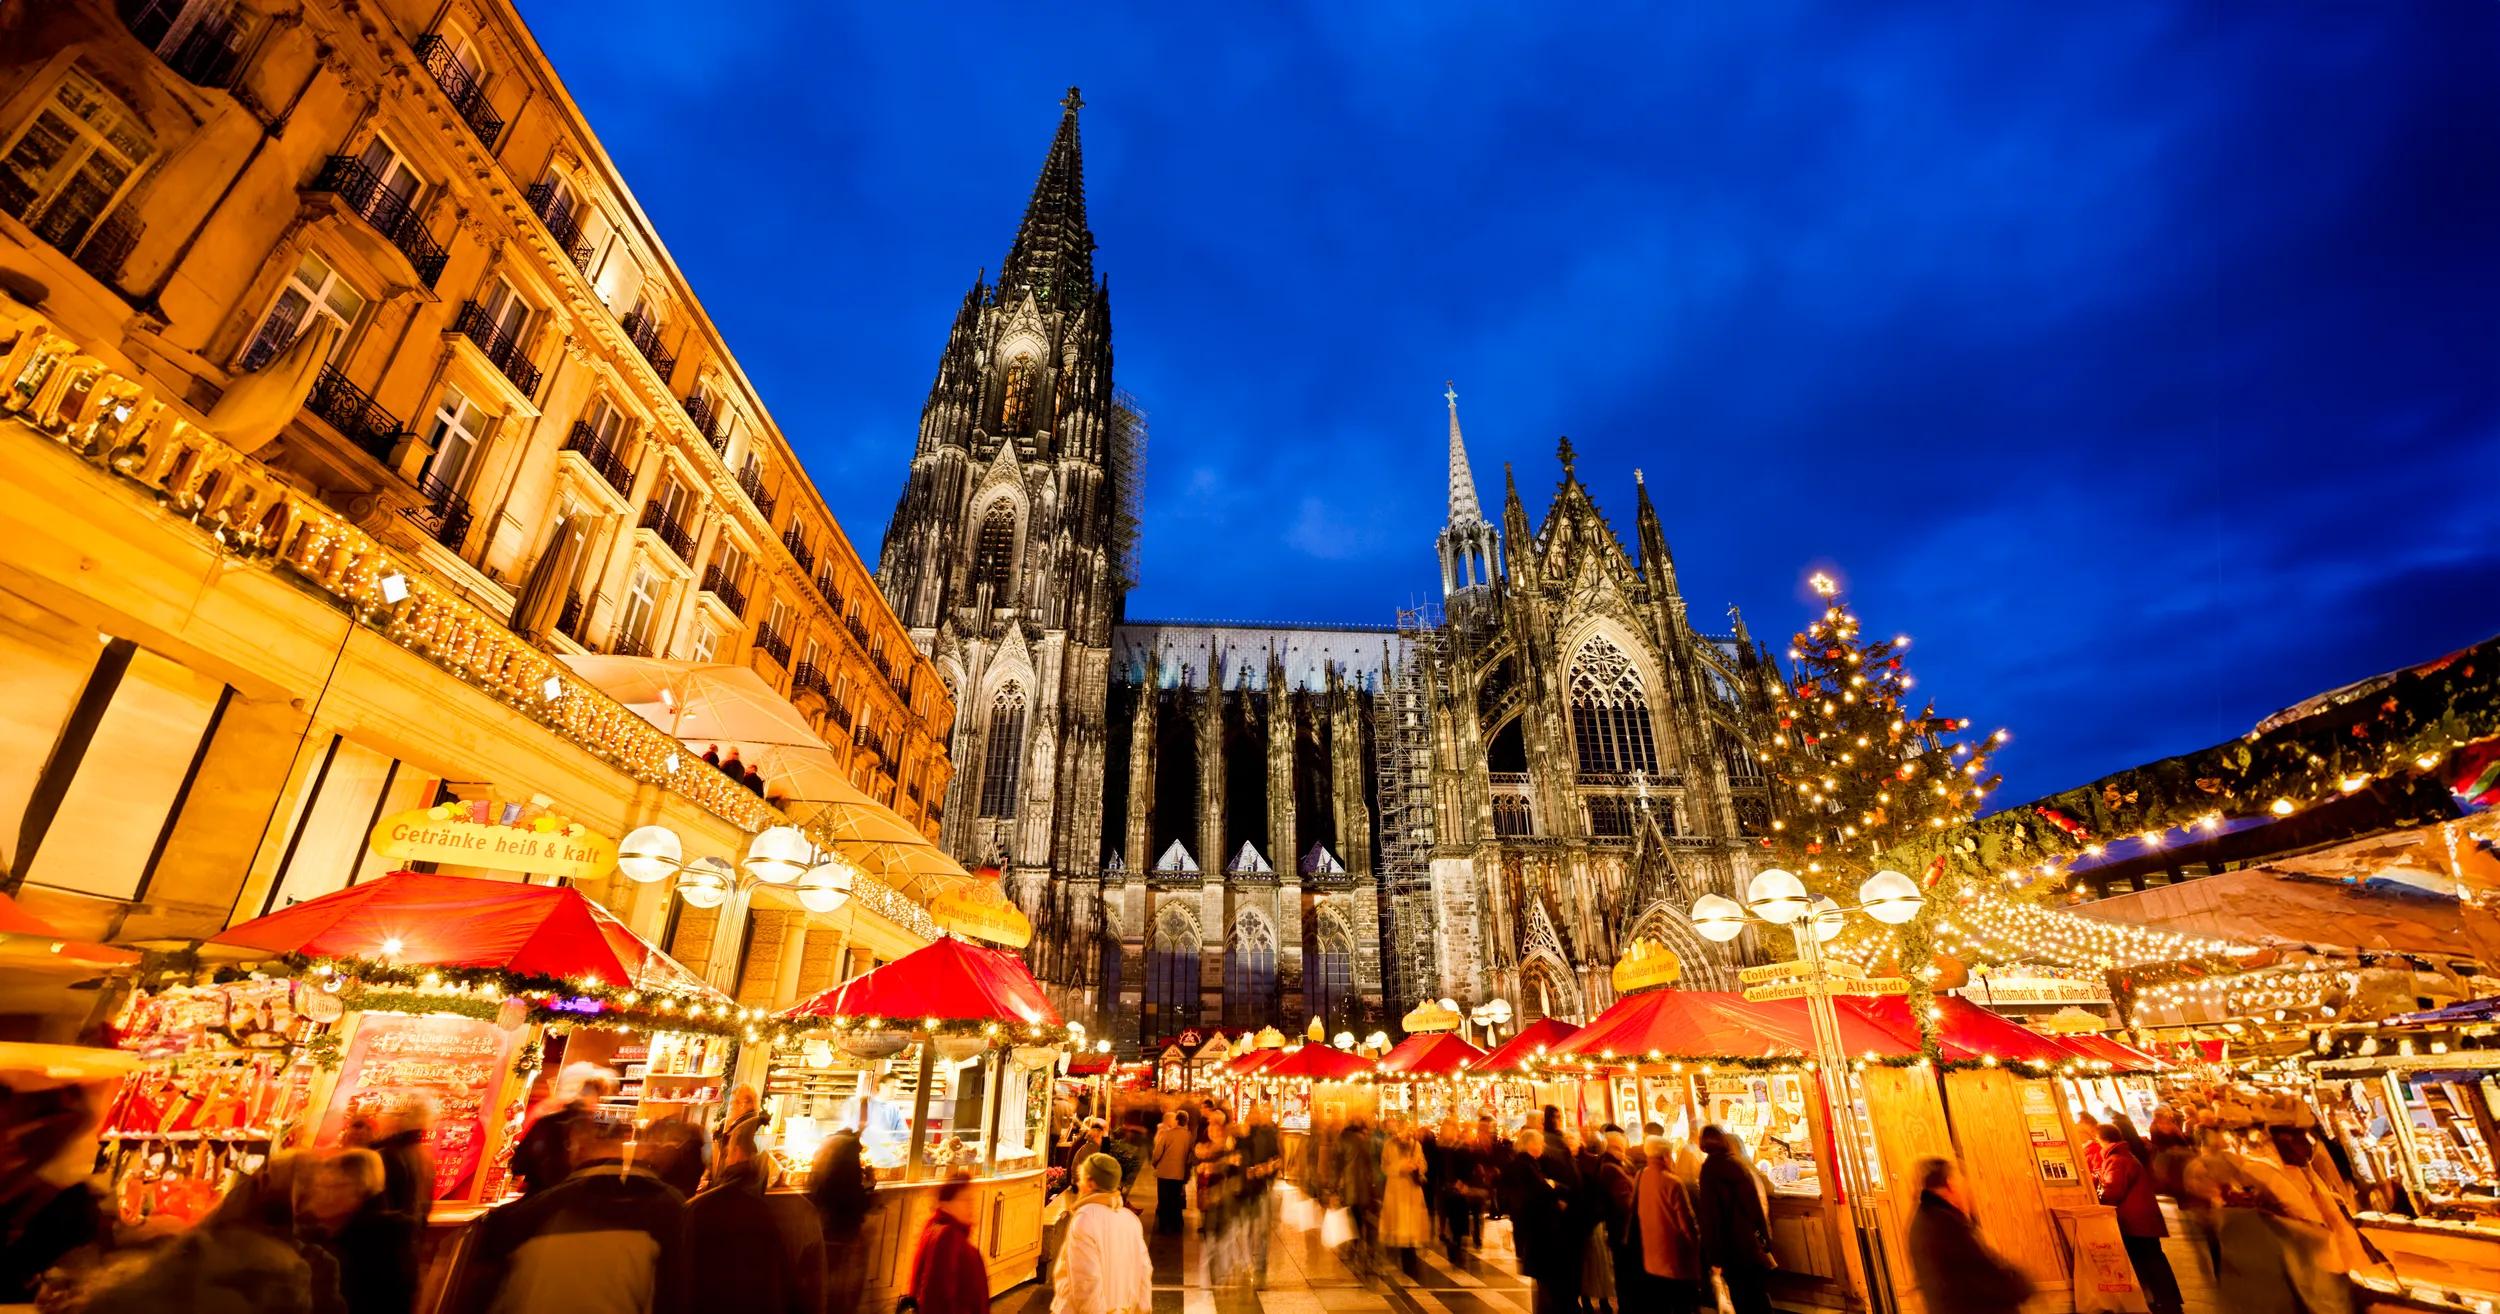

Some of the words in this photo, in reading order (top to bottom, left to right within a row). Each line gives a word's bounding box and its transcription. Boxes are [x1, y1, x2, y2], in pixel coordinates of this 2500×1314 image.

[391, 823, 487, 851] Getränke
[495, 836, 538, 857] heiß
[544, 842, 557, 859] &
[564, 845, 601, 864] kalt
[937, 902, 1001, 930] Selbstgemachte
[1744, 966, 1791, 981] Toilette
[1749, 985, 1807, 1001] Anlieferung
[1846, 981, 1905, 994] Altstadt
[1965, 986, 2040, 1001] eihnchtsmarkt
[2042, 988, 2057, 1000] am
[2058, 985, 2091, 1000] Kölner
